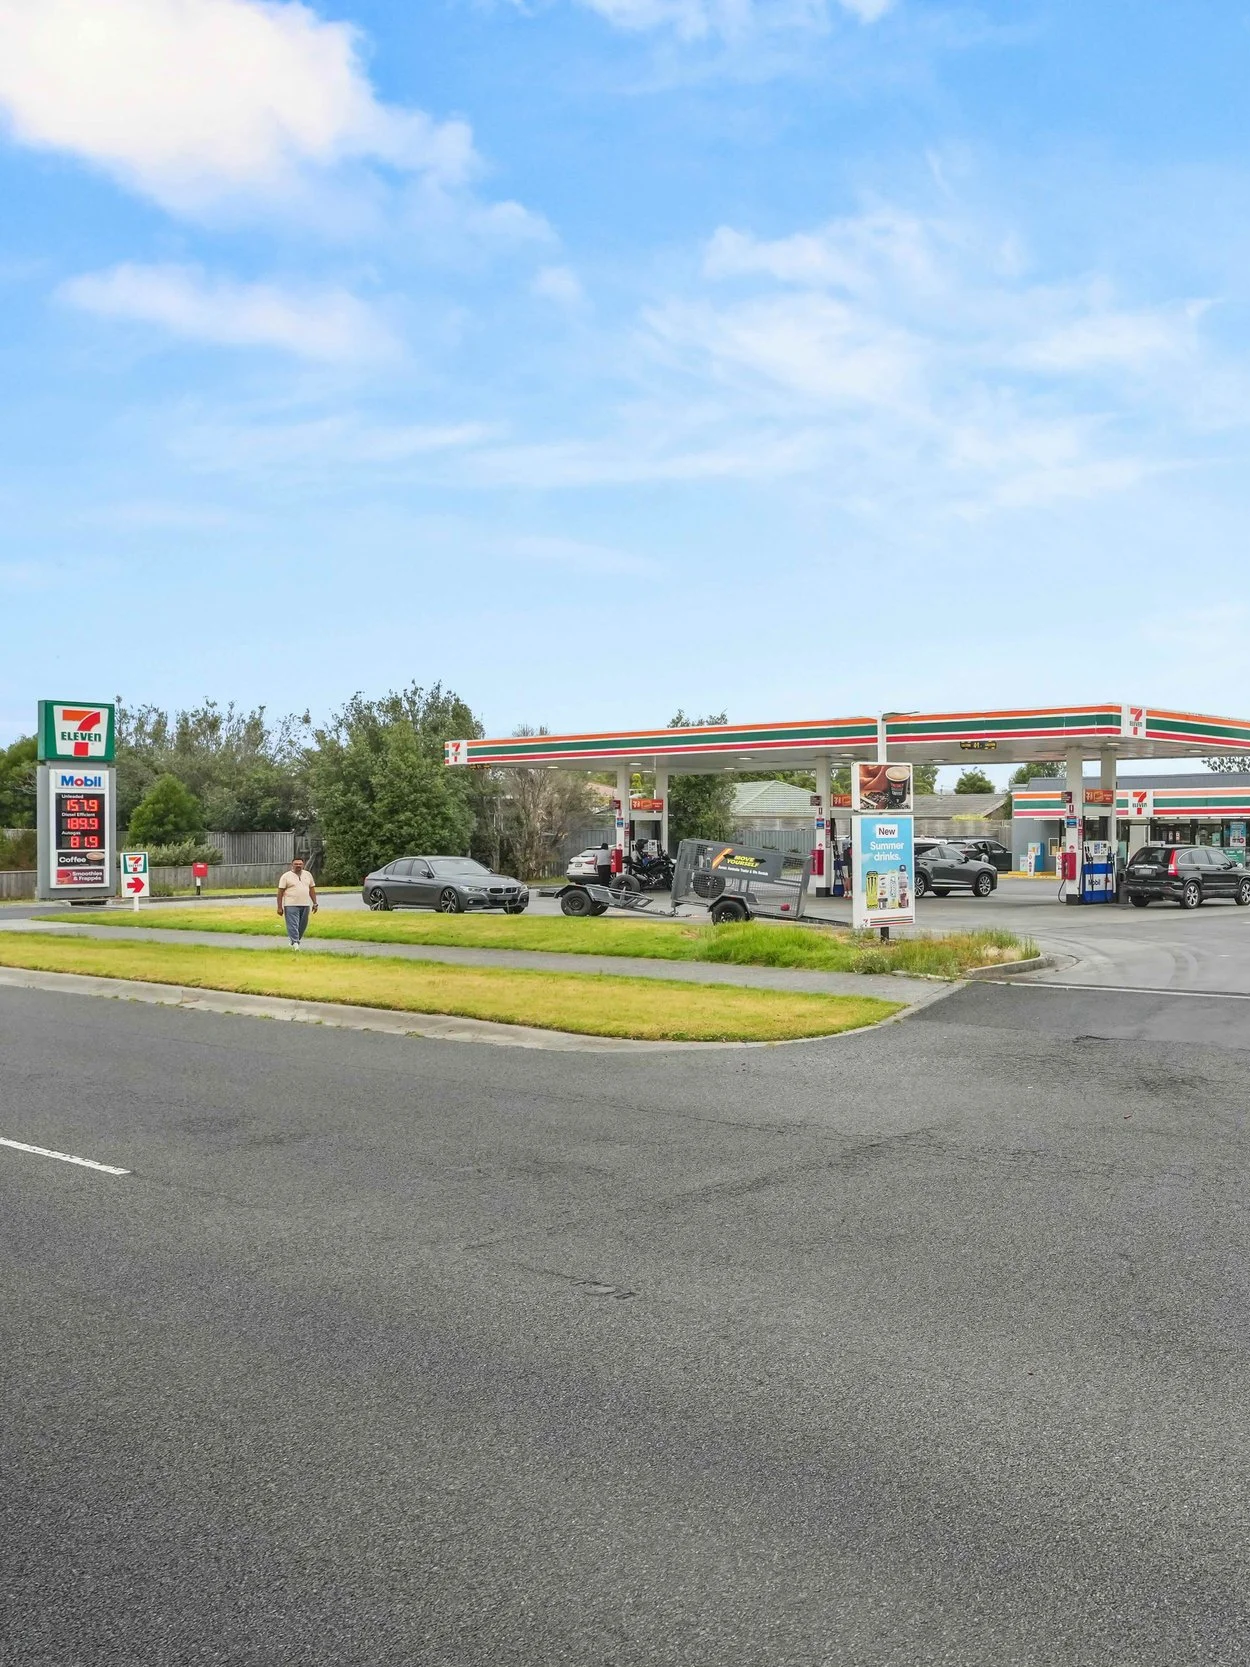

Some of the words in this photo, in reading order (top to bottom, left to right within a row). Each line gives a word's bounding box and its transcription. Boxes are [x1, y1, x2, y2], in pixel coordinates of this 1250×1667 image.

[1130, 707, 1143, 735] 7
[63, 709, 101, 756] 7
[61, 775, 102, 787] Mobil
[1132, 791, 1147, 815] 7
[878, 827, 896, 836] New
[870, 841, 905, 851] Summer
[873, 852, 902, 861] drinks.
[727, 859, 760, 868] YOURSELF
